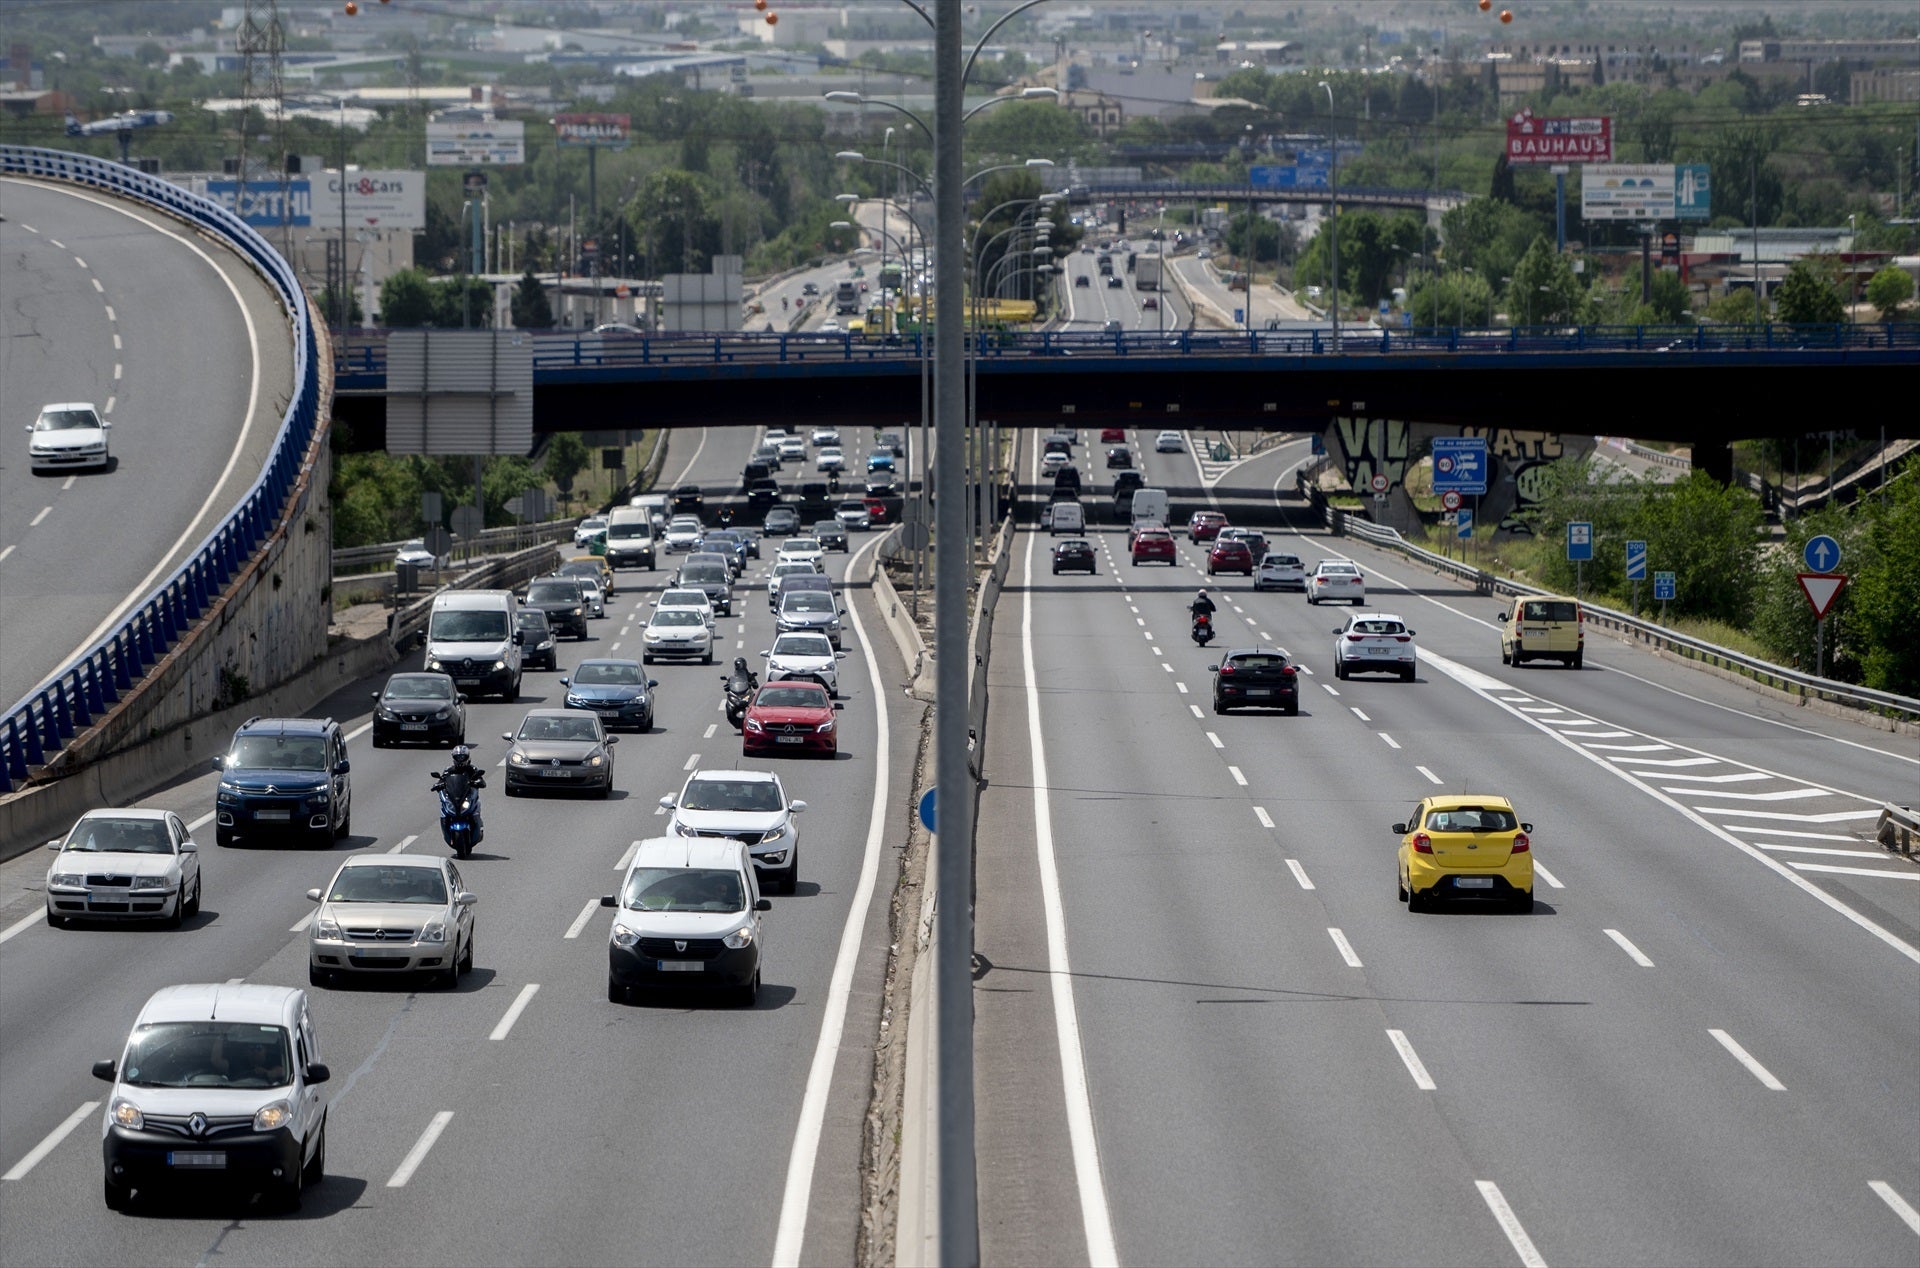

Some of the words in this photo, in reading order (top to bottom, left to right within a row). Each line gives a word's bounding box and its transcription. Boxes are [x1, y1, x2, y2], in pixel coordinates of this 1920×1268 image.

[1512, 138, 1606, 153] BAUHAUS
[328, 178, 403, 195] Cars&Cars
[1446, 496, 1459, 504] 100
